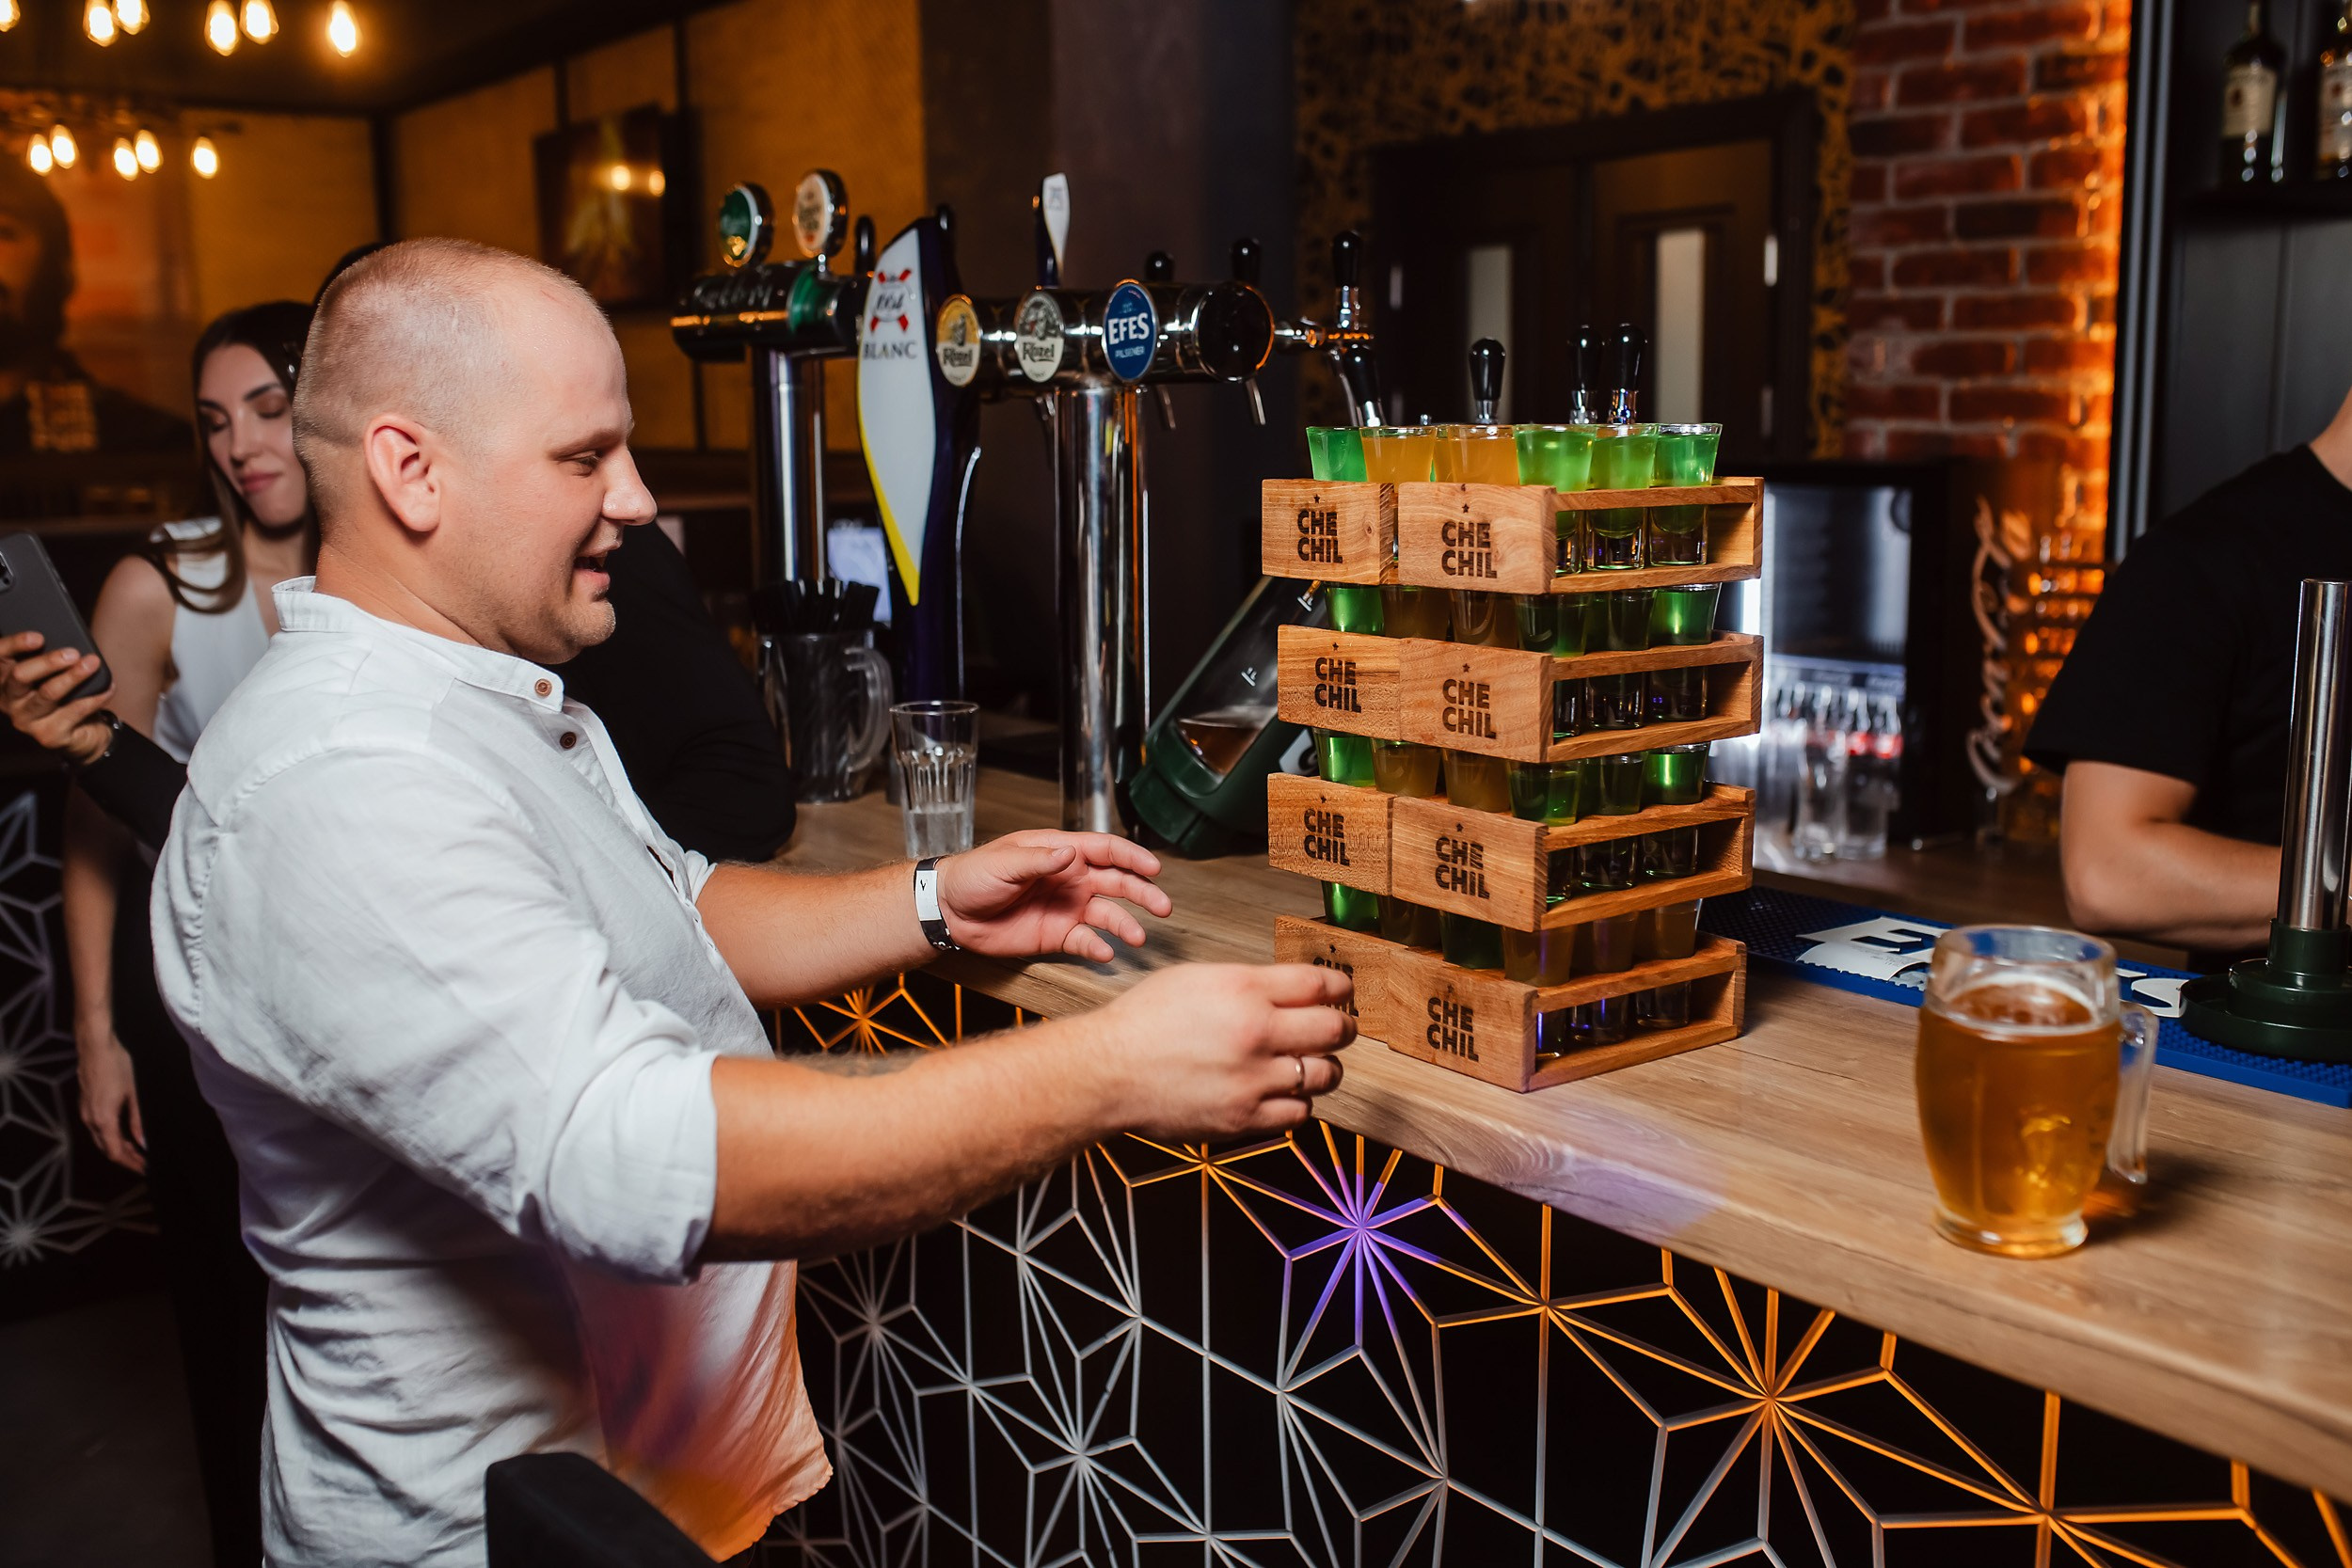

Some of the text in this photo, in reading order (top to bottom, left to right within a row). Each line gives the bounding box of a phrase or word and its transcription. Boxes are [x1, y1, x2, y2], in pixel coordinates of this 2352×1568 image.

[1107, 312, 1150, 345] EFES
[864, 341, 917, 360] BLANC
[1022, 341, 1055, 363] Kozel
[1297, 509, 1337, 536] CHE
[1441, 521, 1491, 549] CHE
[1297, 536, 1343, 564] CHIL
[1441, 549, 1498, 579] CHIL
[1315, 657, 1357, 686] CHE
[1314, 683, 1362, 713] CHIL
[1442, 678, 1490, 709] CHE
[1442, 706, 1497, 739] CHIL
[1304, 808, 1344, 839] CHE
[1304, 834, 1350, 866] CHIL
[1436, 836, 1484, 870] CHE
[1435, 863, 1490, 899] CHIL
[1427, 997, 1474, 1034] CHE
[1426, 1023, 1480, 1062] CHIL
